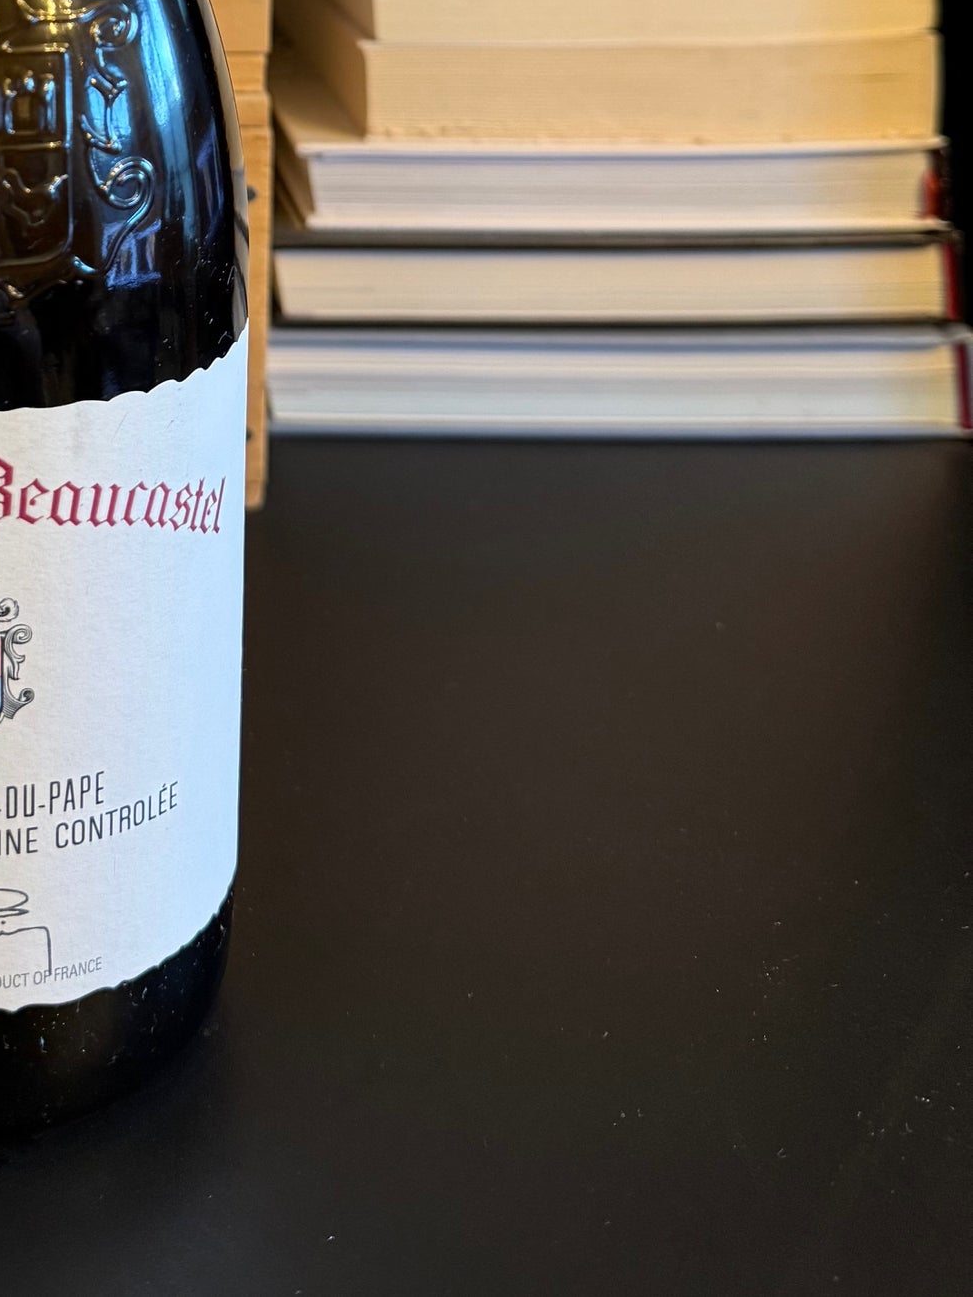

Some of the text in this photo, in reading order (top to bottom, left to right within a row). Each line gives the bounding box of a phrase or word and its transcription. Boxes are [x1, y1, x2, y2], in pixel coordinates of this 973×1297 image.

[55, 781, 178, 849] CONTROLÉE
[33, 969, 52, 985] OF
[54, 956, 103, 982] FRANCE
